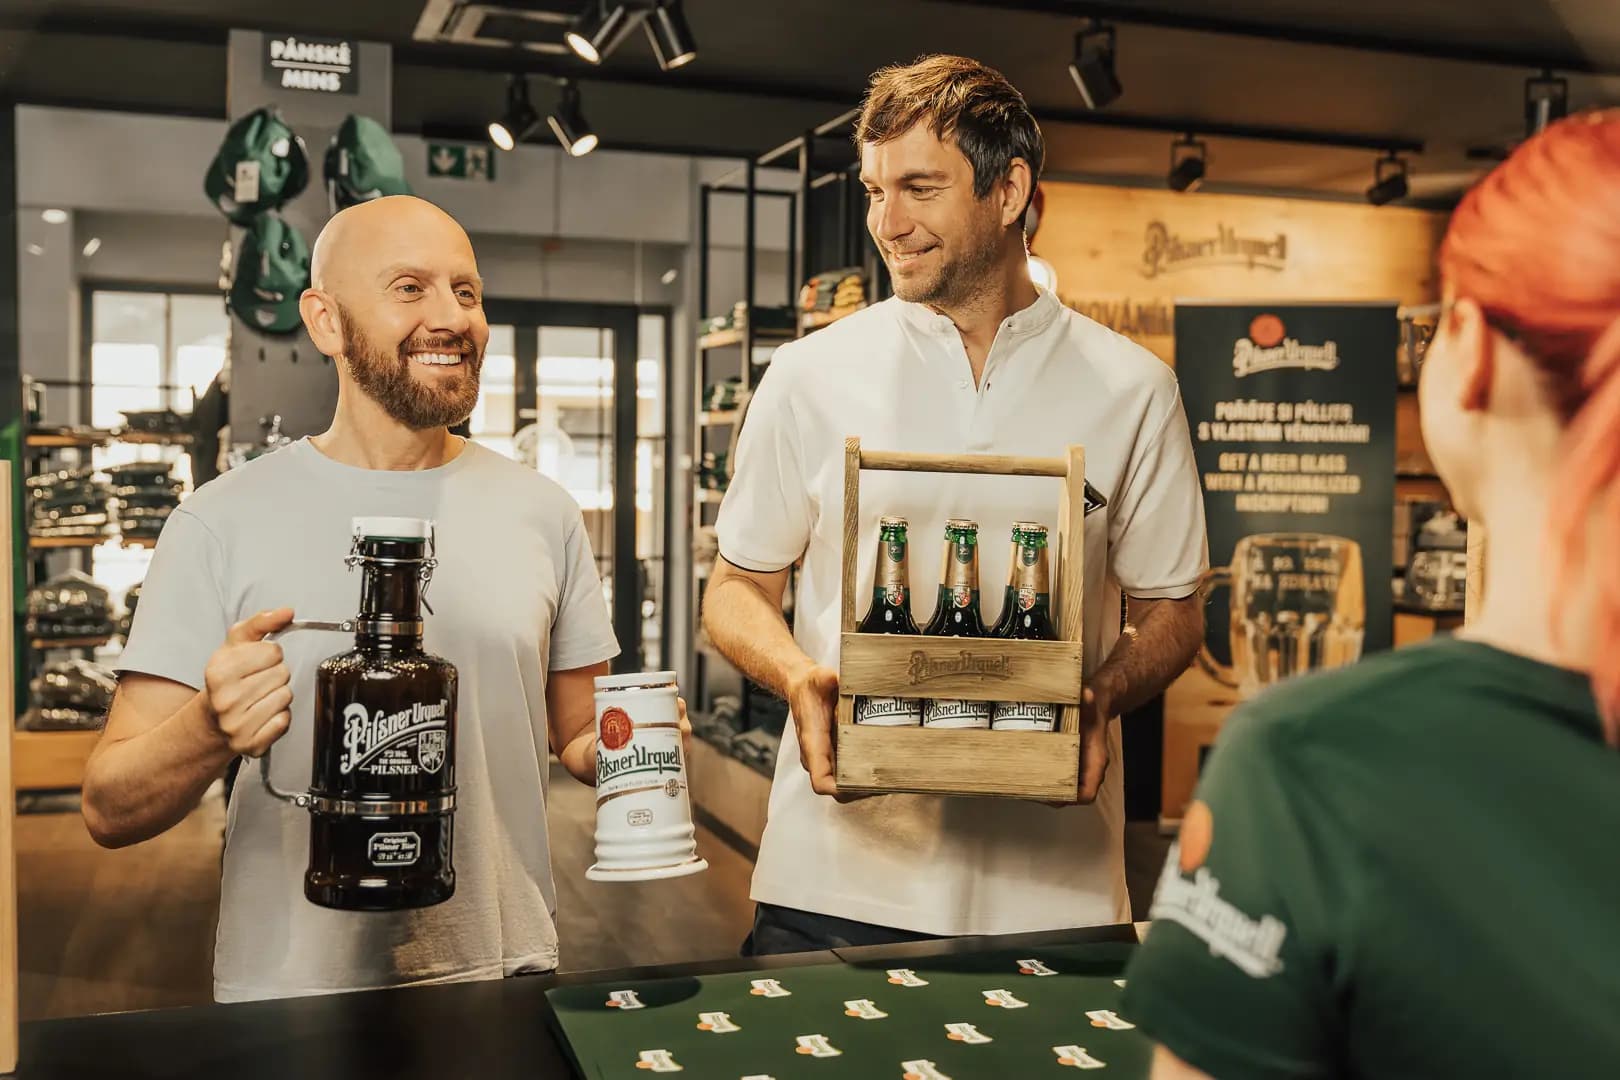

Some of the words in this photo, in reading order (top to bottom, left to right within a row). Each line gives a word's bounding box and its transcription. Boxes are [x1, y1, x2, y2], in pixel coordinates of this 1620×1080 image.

[270, 37, 351, 66] PÁNSKÉ
[1198, 421, 1210, 441] S
[1219, 453, 1247, 471] GET
[1248, 453, 1260, 472] A
[1261, 453, 1299, 472] BEER
[1299, 454, 1347, 473] GLASS
[1204, 473, 1244, 491] WITH
[1244, 473, 1256, 491] A
[907, 650, 962, 686] Pilsner
[959, 650, 1010, 681] Urquell
[370, 765, 419, 775] PILSNER
[596, 749, 635, 788] Pilsner
[632, 743, 682, 775] Urquell
